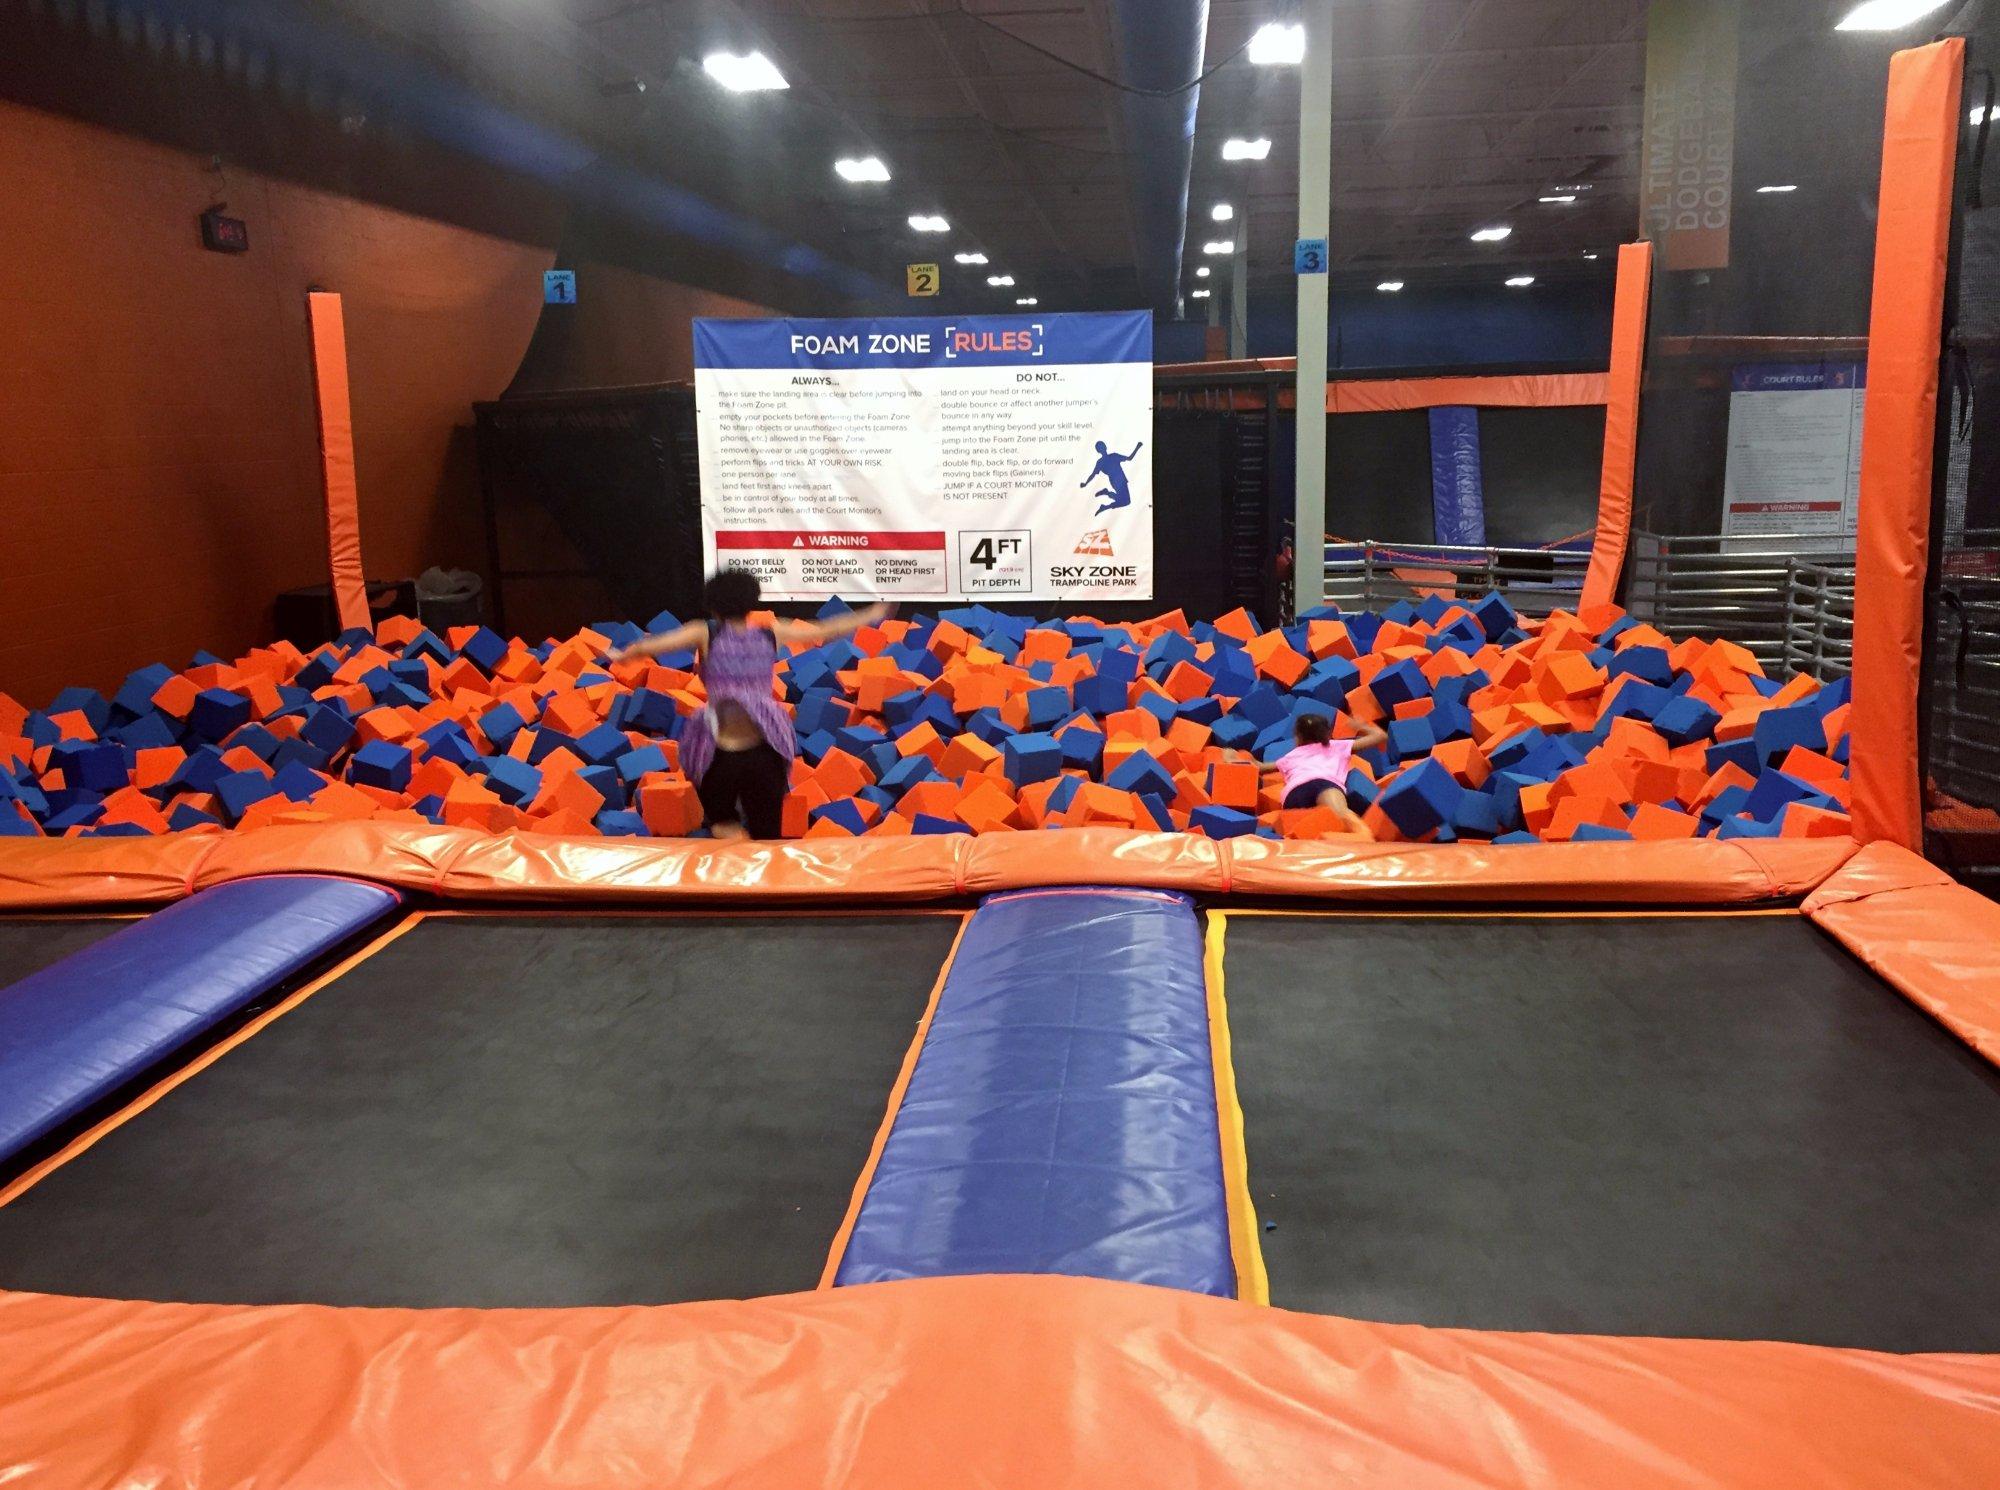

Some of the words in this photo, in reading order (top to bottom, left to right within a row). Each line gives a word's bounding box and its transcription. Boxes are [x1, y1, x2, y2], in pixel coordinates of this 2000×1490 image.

[1703, 126, 1729, 229] COURT
[1299, 242, 1323, 250] LANE
[1303, 251, 1320, 270] 3
[911, 265, 934, 273] LANE
[916, 274, 932, 292] 2
[553, 281, 566, 299] 1
[791, 335, 858, 354] FOAM
[869, 334, 930, 353] ZONE
[954, 332, 1033, 352] RULES
[791, 377, 840, 385] ALWAYS...
[1016, 374, 1032, 382] DO
[1035, 373, 1065, 382] NOT...
[773, 391, 800, 399] landing
[756, 424, 782, 432] objects
[972, 424, 1005, 432] anything
[1007, 423, 1037, 431] beyond
[1038, 423, 1055, 431] your
[1057, 421, 1072, 429] skill
[942, 437, 961, 445] jump
[1017, 435, 1036, 443] Zone
[721, 459, 751, 467] perform
[752, 459, 767, 467] flips
[992, 470, 1008, 478] flips
[809, 535, 869, 546] WARNING
[970, 538, 997, 570] 4
[998, 539, 1022, 554] FT
[752, 567, 763, 575] OR
[764, 567, 787, 575] LAND
[1051, 566, 1085, 577] SKY
[1089, 566, 1136, 577] ZONE
[972, 579, 987, 587] PIT
[989, 579, 1021, 587] DEPTH
